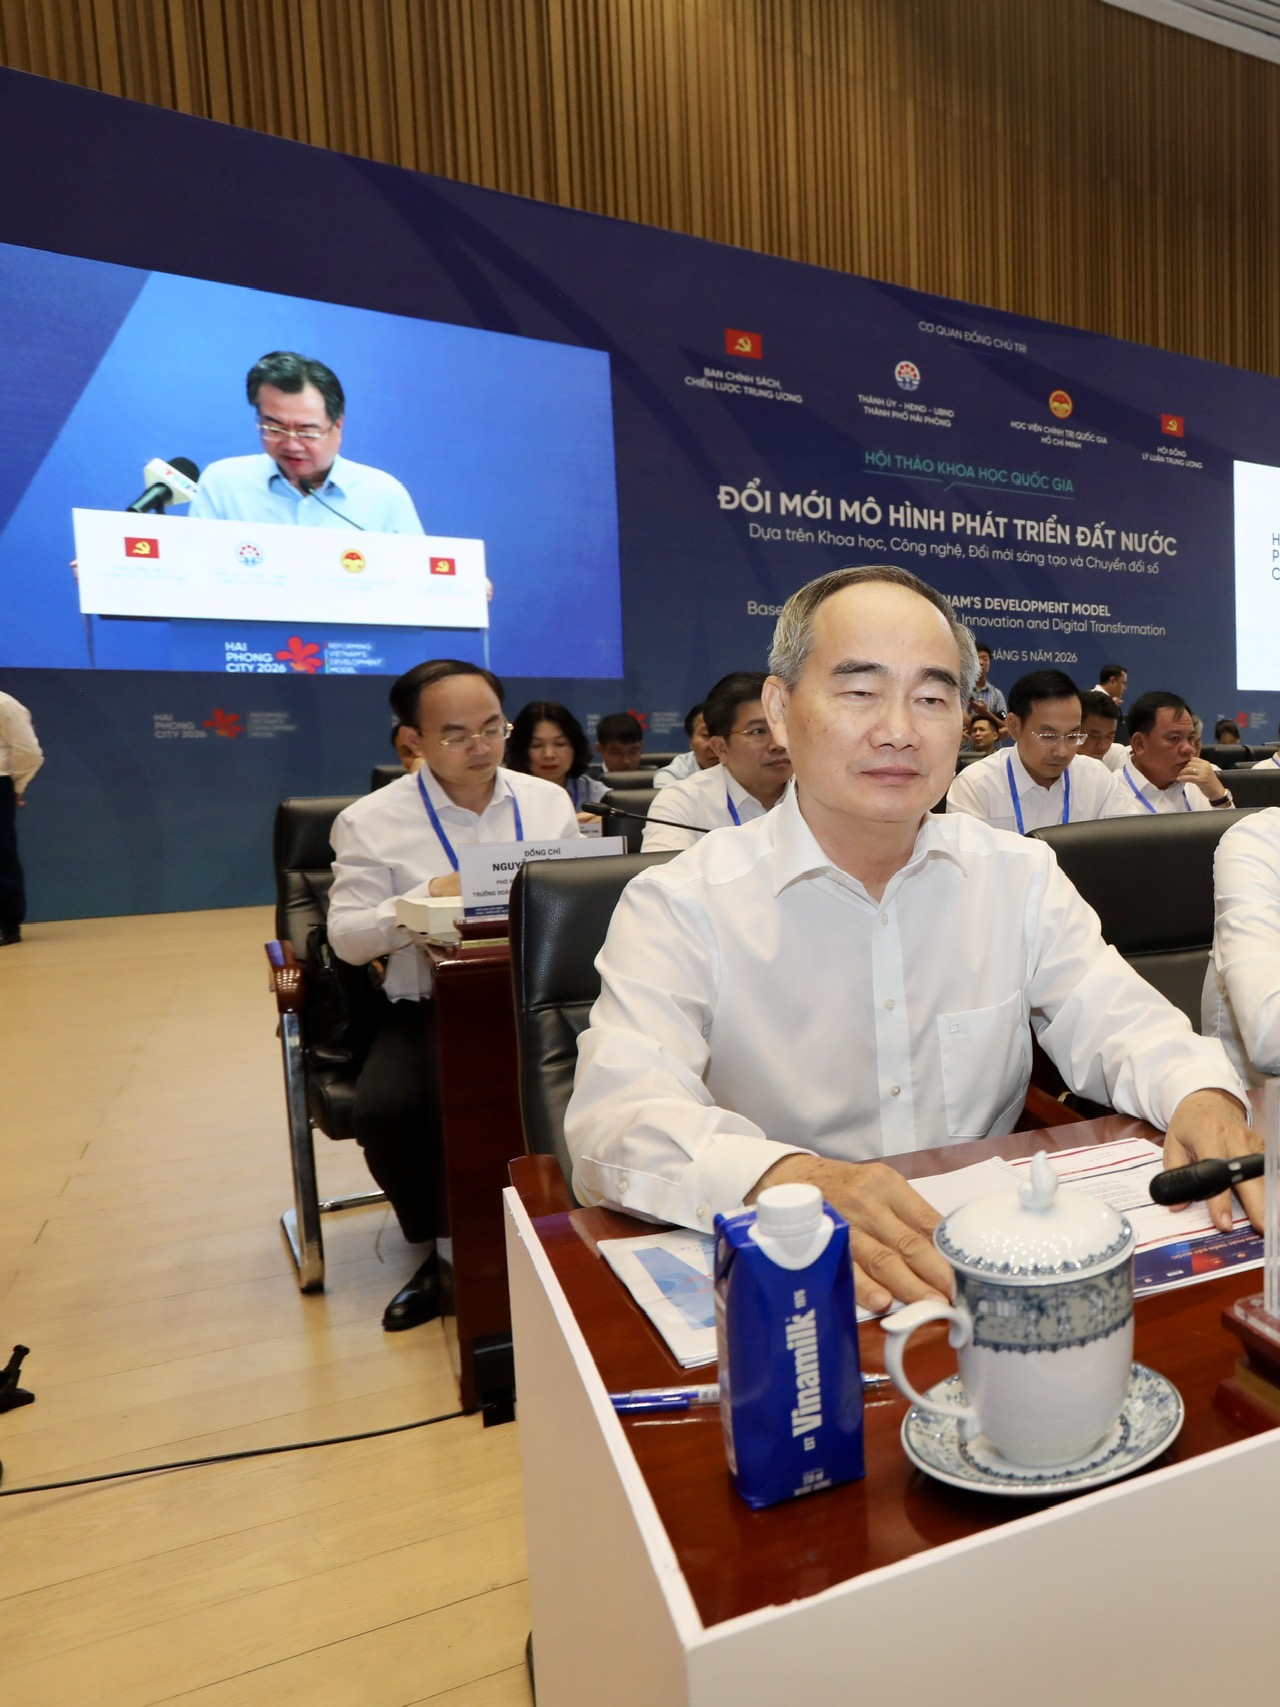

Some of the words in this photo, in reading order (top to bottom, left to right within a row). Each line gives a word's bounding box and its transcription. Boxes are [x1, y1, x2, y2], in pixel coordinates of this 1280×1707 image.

[936, 324, 963, 340] QUAN
[704, 367, 724, 379] BAN
[744, 386, 773, 400] TRUNG
[1065, 440, 1082, 449] MINH
[1097, 435, 1108, 445] GIA
[865, 450, 891, 469] HỘI
[895, 454, 934, 473] THẢO
[938, 460, 975, 478] KHOA
[978, 467, 1008, 485] HỌC
[1011, 470, 1050, 489] QUỐC
[1052, 477, 1074, 492] GIA
[717, 477, 772, 514] ĐỔI
[780, 490, 832, 520] MỚI
[840, 496, 882, 525] MÔ
[889, 501, 945, 532] HÌNH
[952, 511, 1008, 538] PHÁT
[1014, 514, 1070, 545] TRIỂN
[1076, 521, 1116, 550] ĐẤT
[1121, 530, 1178, 556] NƯỚC
[749, 522, 781, 542] Dựa
[786, 528, 814, 543] trên
[818, 530, 855, 548] Khoa
[858, 534, 886, 552] học,
[890, 537, 926, 557] Công
[930, 542, 965, 559] nghệ,
[968, 544, 989, 558] Đổi
[992, 548, 1014, 561] mới
[1016, 551, 1044, 567] sáng
[1048, 554, 1067, 567] tạo
[1070, 556, 1084, 567] và
[1086, 556, 1126, 572] Chuyển
[1128, 559, 1144, 573] đổi
[1147, 562, 1159, 574] số
[747, 601, 784, 616] Base
[942, 594, 981, 610] NAM'S
[984, 597, 1070, 615] DEVELOPMENT
[1072, 602, 1111, 617] MODEL
[961, 614, 1024, 630] Innovation
[1026, 616, 1050, 630] and
[1052, 618, 1088, 634] Digital
[1090, 620, 1166, 636] Transformation
[225, 642, 248, 652] HAI
[226, 652, 274, 662] PHONG
[992, 647, 1019, 662] HÁNG
[1022, 651, 1028, 661] 5
[1030, 648, 1052, 662] NĂM
[1055, 652, 1078, 663] 2026
[225, 662, 255, 673] CITY
[256, 663, 287, 674] 2026
[524, 848, 546, 858] ĐỒNG
[548, 848, 561, 856] CHÍ
[786, 1308, 822, 1438] Vinamilk
